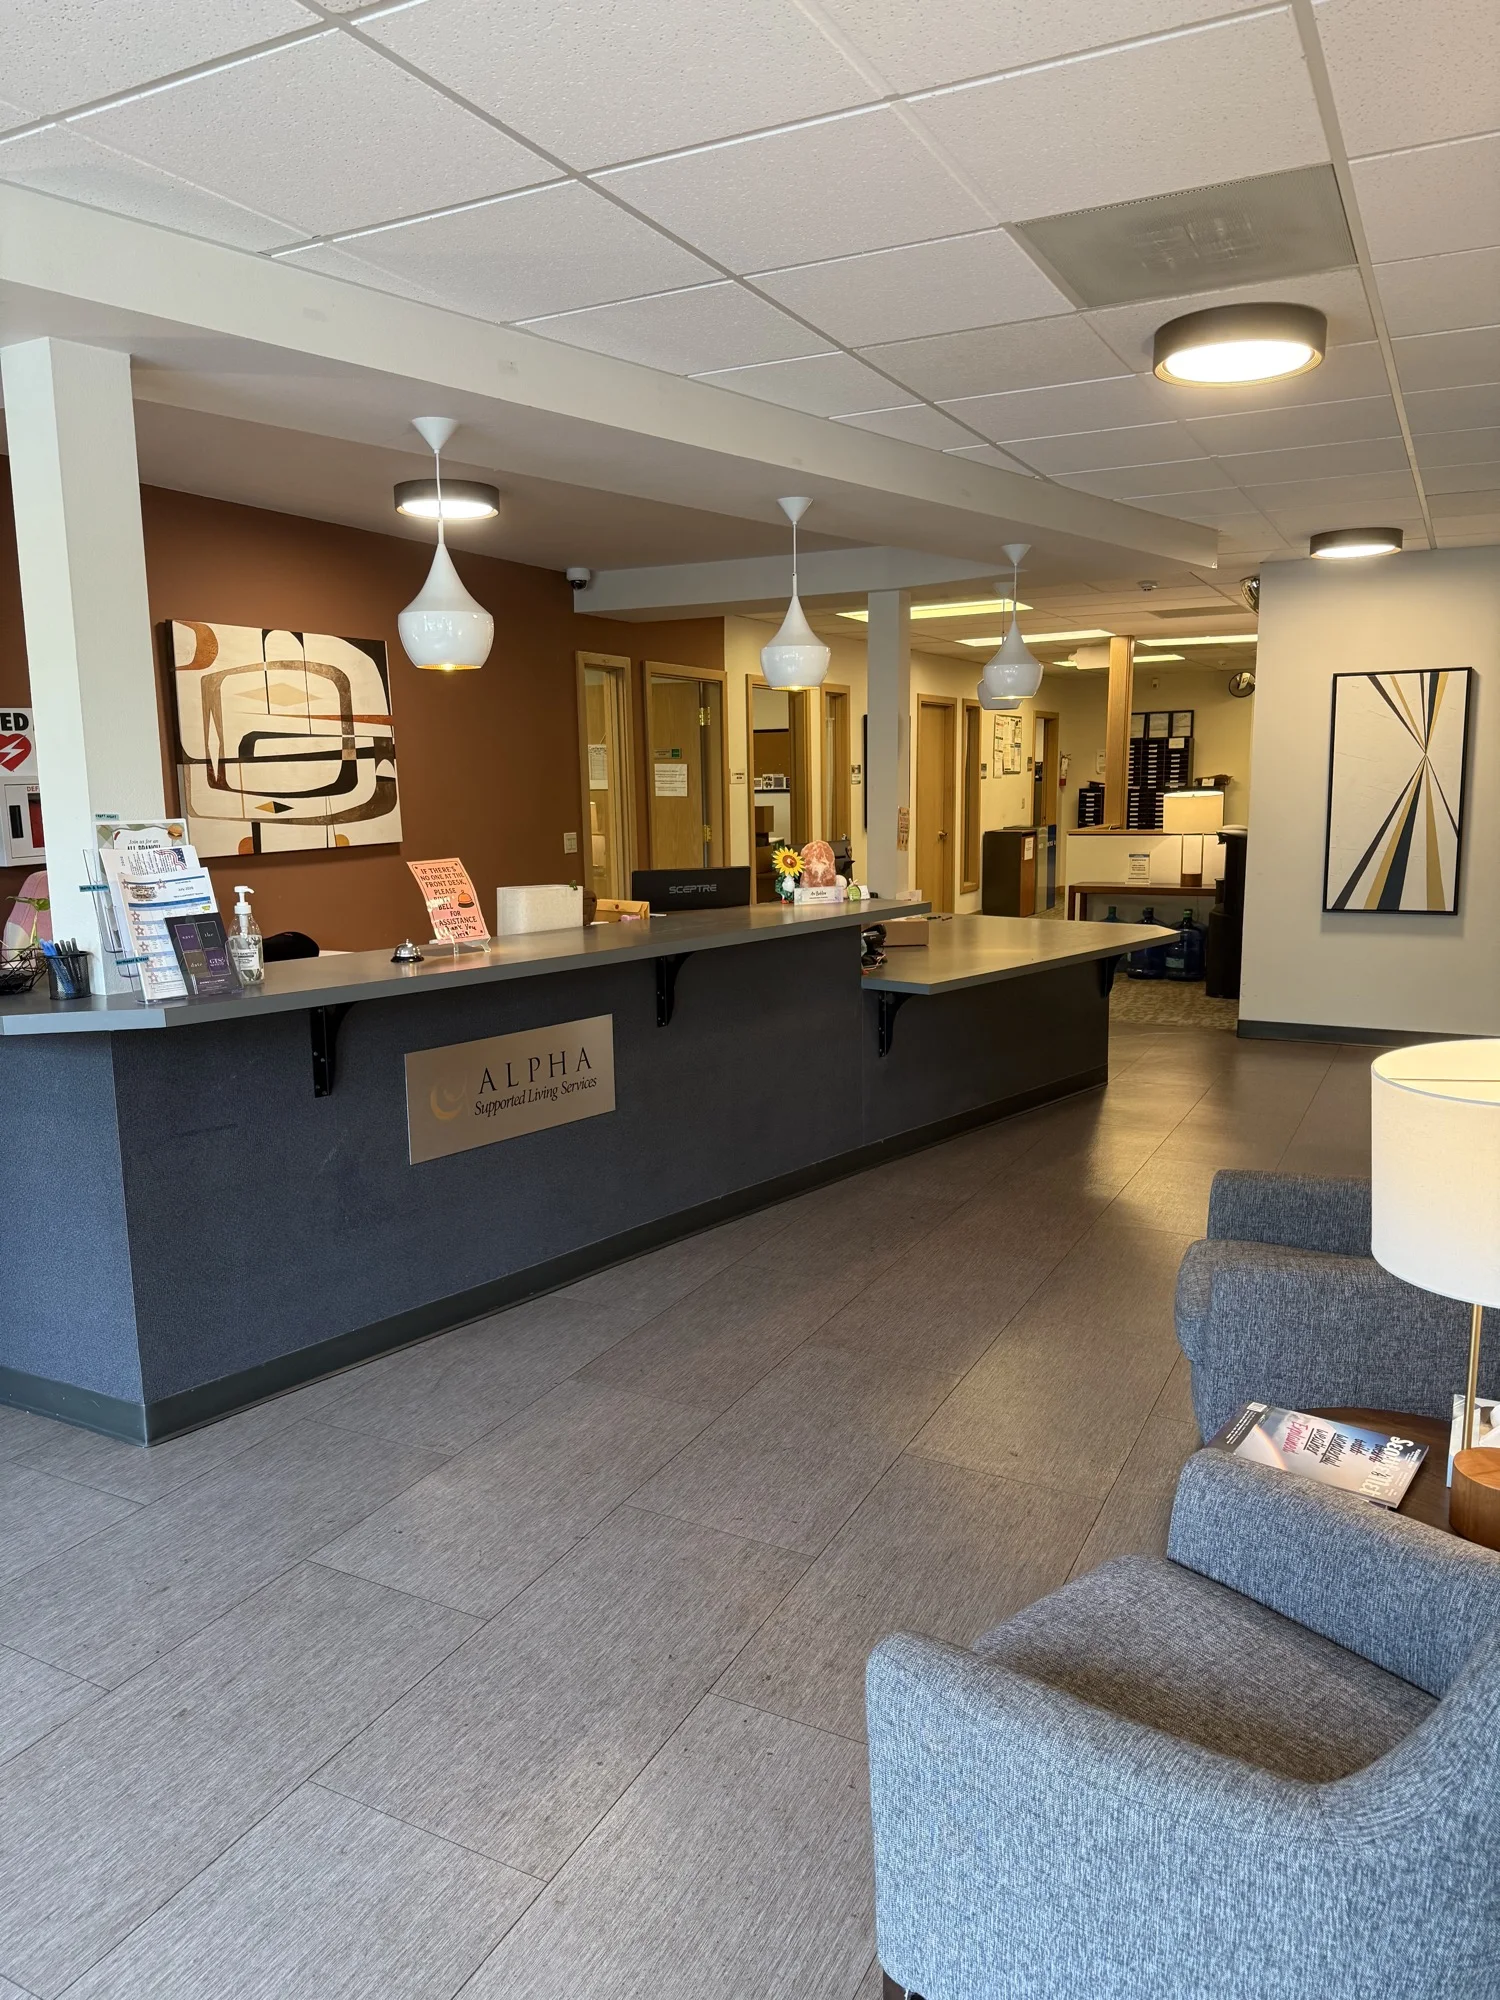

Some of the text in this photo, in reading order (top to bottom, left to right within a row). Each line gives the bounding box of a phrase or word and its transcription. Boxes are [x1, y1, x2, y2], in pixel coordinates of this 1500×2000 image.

[428, 866, 457, 874] THERE'S
[669, 884, 717, 894] SCEPTRE
[439, 916, 478, 926] ASSISTANCE
[478, 1046, 592, 1095] ALPHA
[474, 1076, 598, 1118] Supported Living Services
